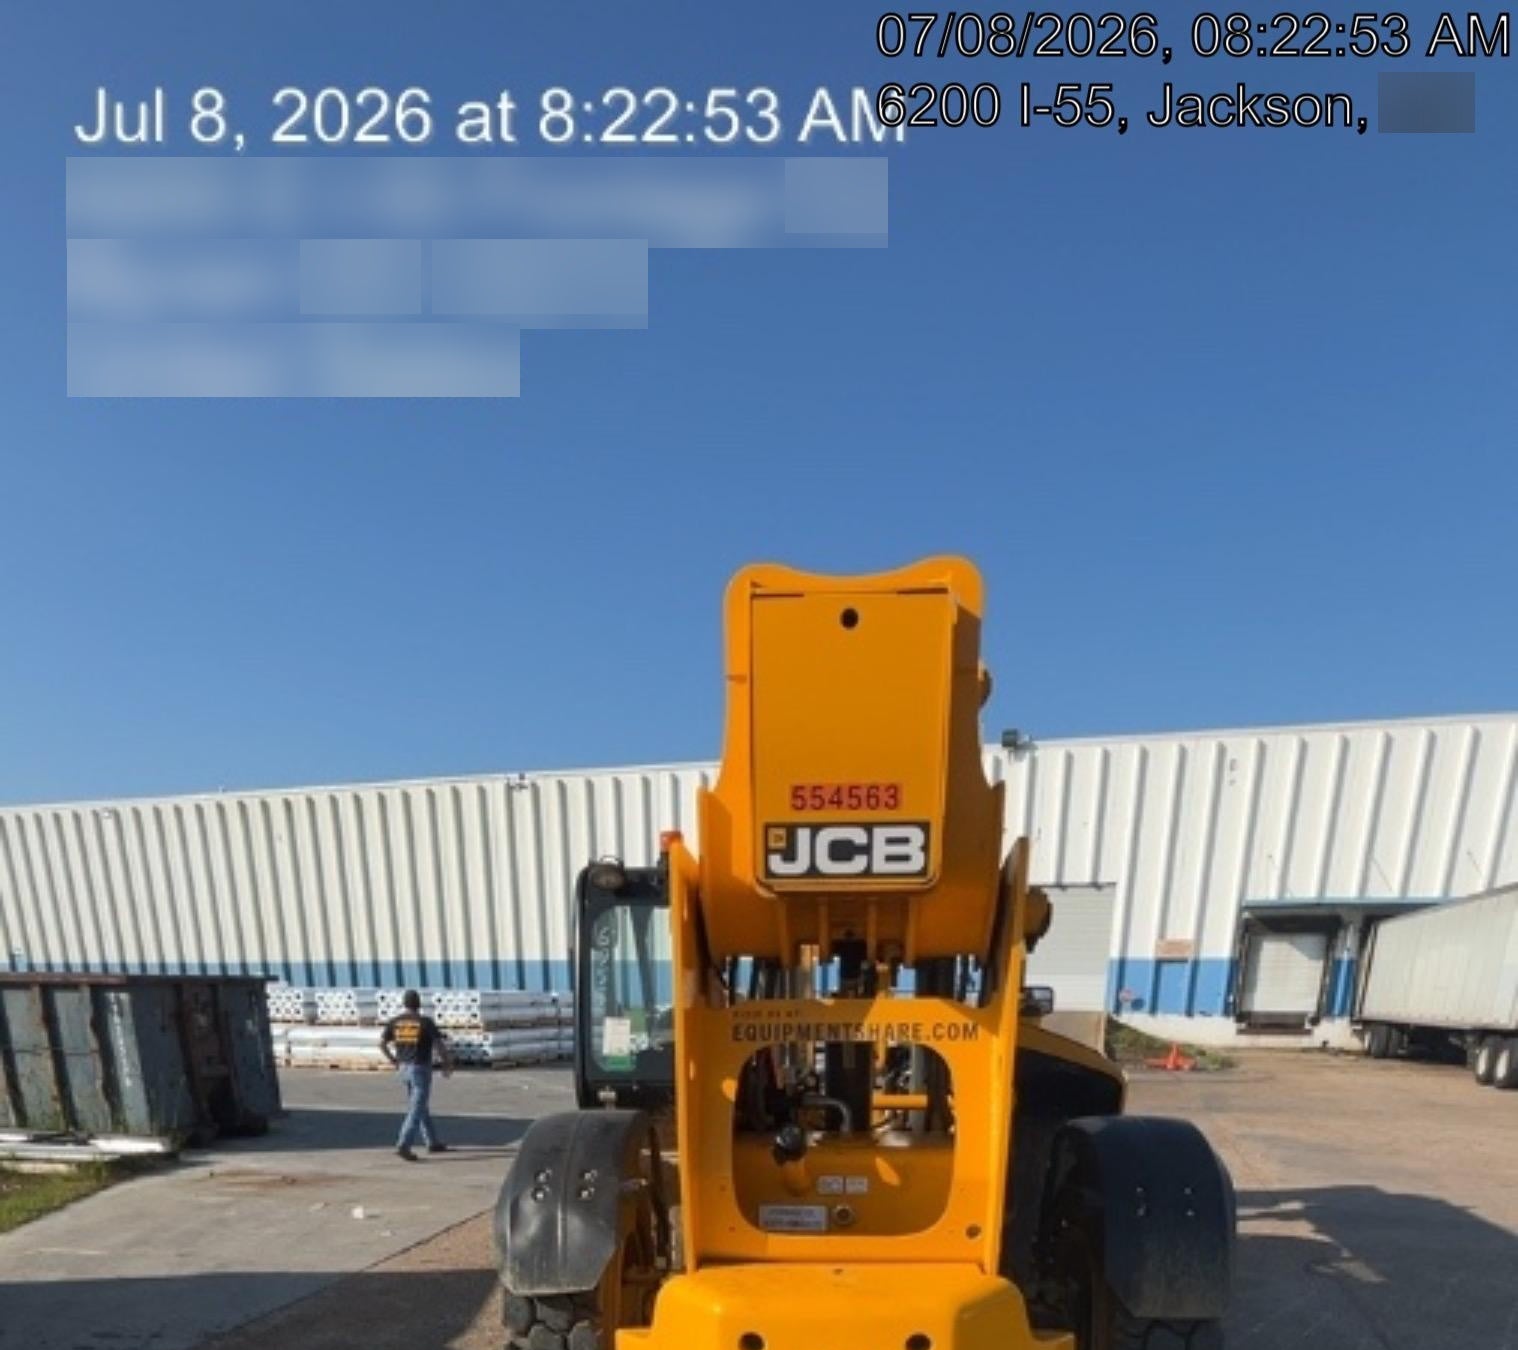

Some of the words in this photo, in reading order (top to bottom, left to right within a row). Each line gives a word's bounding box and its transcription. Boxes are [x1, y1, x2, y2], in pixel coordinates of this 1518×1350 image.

[790, 785, 901, 811] 554563
[767, 826, 926, 875] JCB
[731, 1021, 980, 1042] EQUIPMENTSHARE.COM
